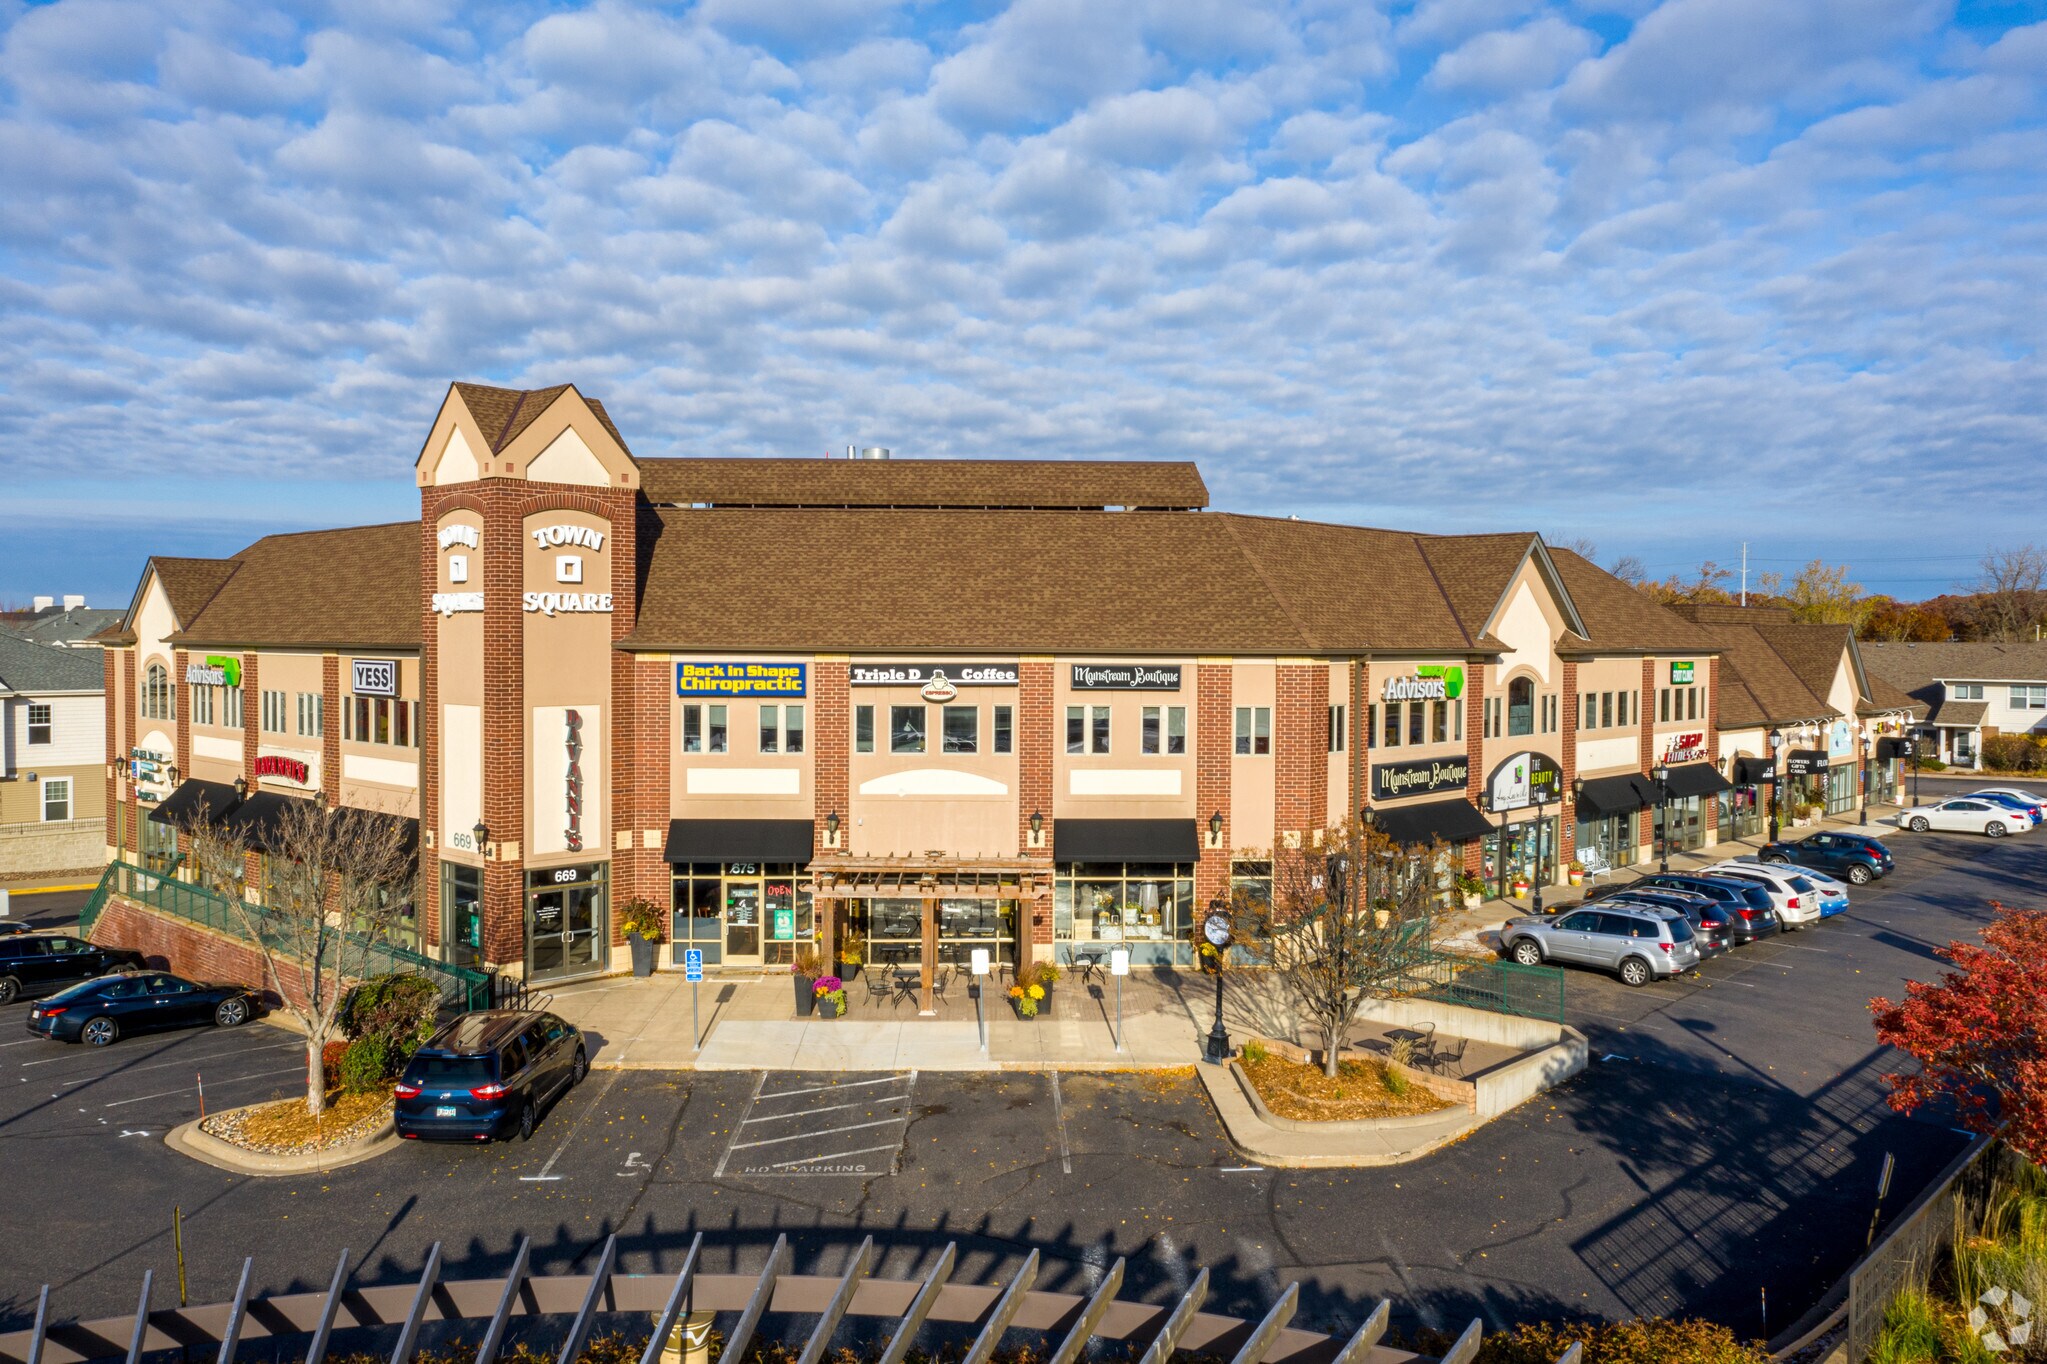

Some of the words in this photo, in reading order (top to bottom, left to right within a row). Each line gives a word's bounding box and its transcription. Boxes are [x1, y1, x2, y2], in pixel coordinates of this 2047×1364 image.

[532, 525, 605, 551] TOWN
[523, 592, 613, 616] SQUARE
[185, 664, 226, 686] Advisors
[356, 662, 394, 693] YESS!
[683, 665, 725, 676] Back
[728, 665, 744, 676] in
[747, 665, 799, 679] Shape
[854, 669, 905, 683] Triple
[908, 669, 921, 680] D
[961, 669, 1015, 680] Coffee
[1074, 666, 1131, 687] Mainstream
[1130, 666, 1179, 687] Boutique
[680, 677, 802, 693] Chiropractic
[1384, 676, 1445, 700] Advisors
[1531, 758, 1541, 771] THE
[1381, 768, 1430, 794] Mainstream
[1428, 762, 1468, 790] Boutique
[1531, 770, 1553, 785] BEAUTY
[453, 832, 472, 849] 669
[554, 869, 577, 882] 669
[731, 863, 756, 874] 675
[767, 884, 793, 897] OPEN
[744, 1165, 770, 1173] NO
[784, 1164, 866, 1172] PARKING
